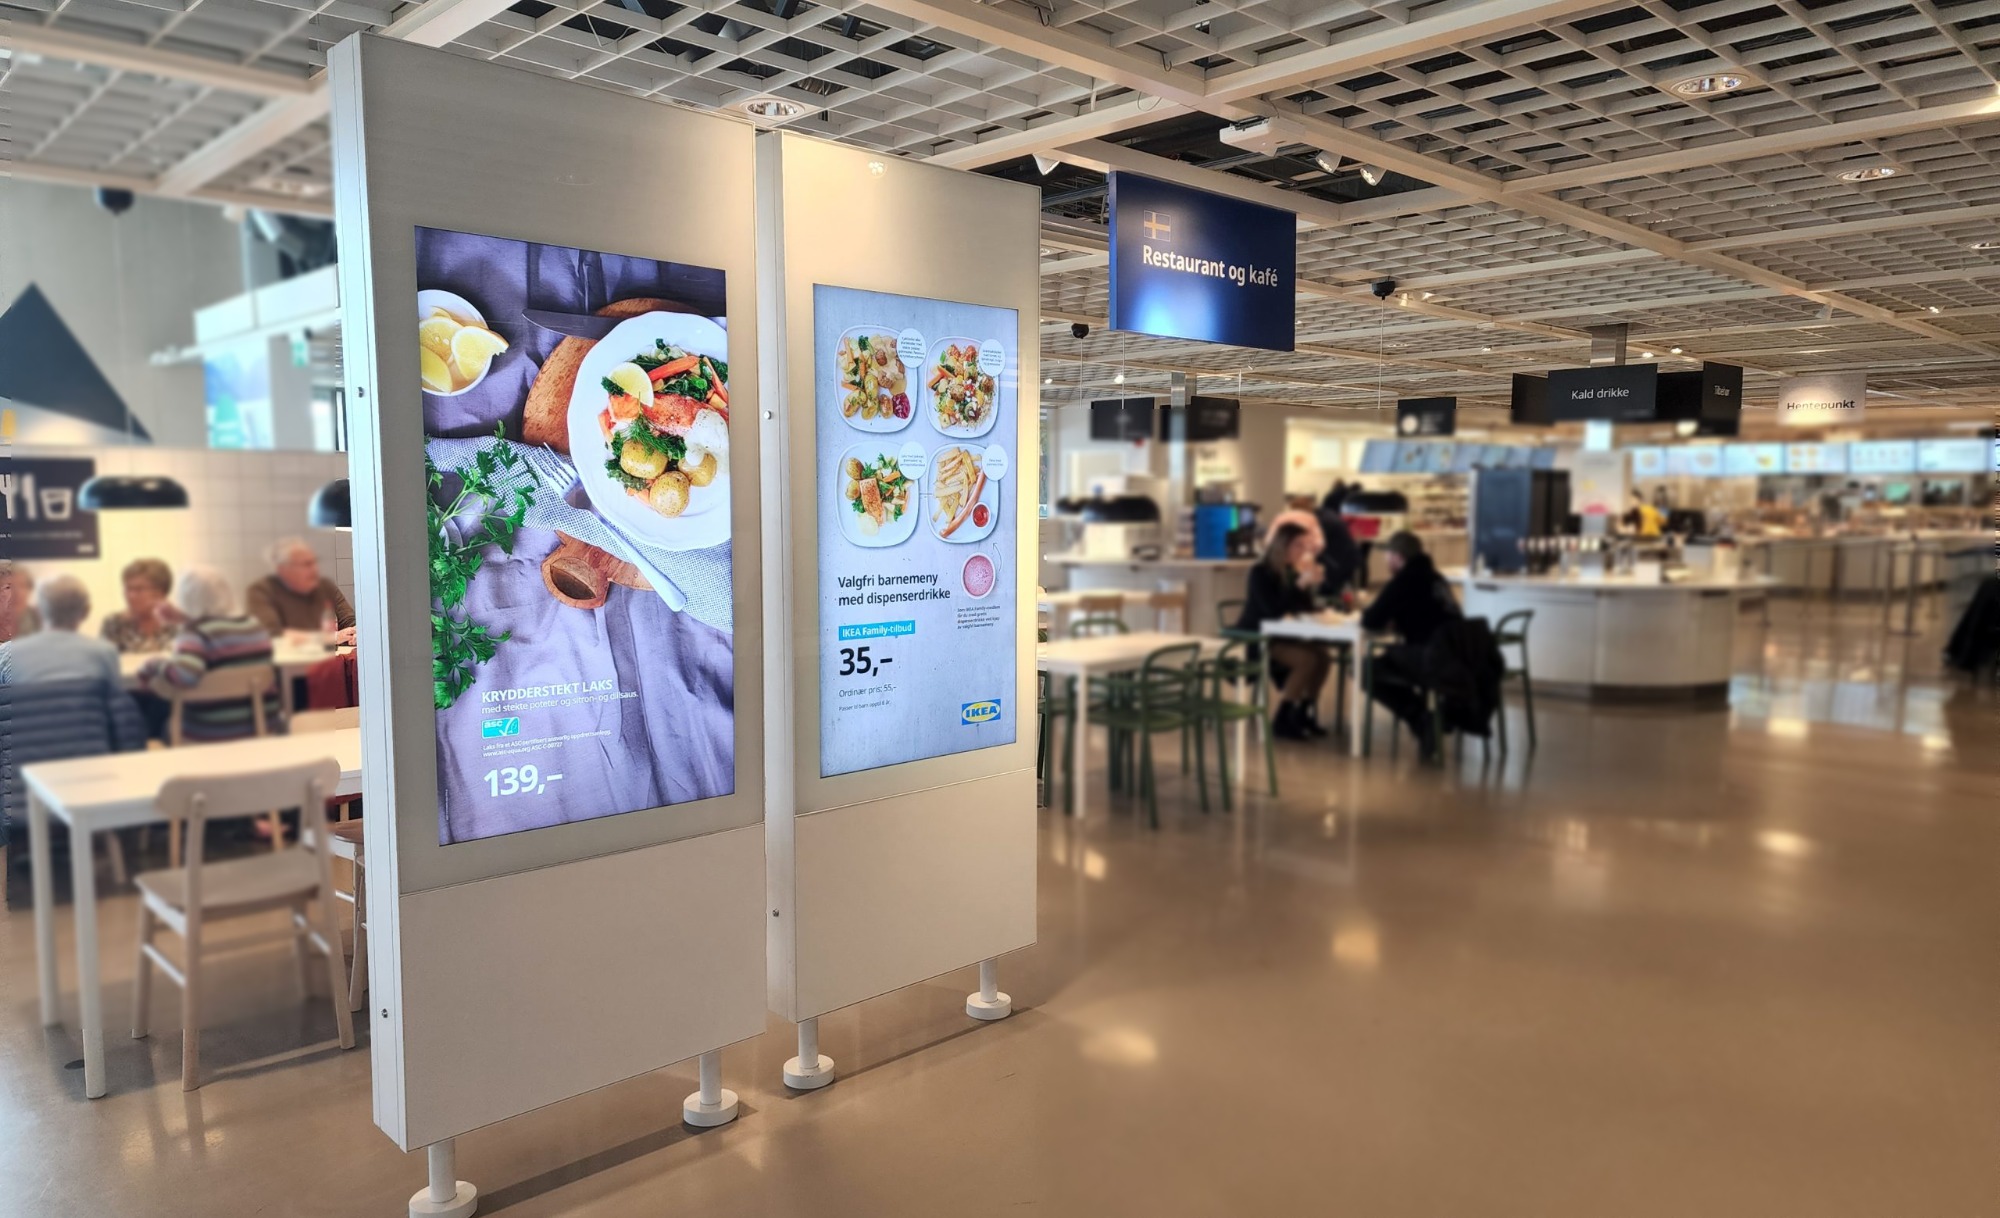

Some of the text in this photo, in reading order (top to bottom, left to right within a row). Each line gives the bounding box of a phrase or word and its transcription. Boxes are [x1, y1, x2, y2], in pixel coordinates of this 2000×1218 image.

[1143, 244, 1278, 287] Restaurant og kafé
[1571, 387, 1630, 400] Kald drikke
[838, 572, 939, 590] Valgfri barnemeny
[838, 588, 951, 606] med dispenserdrikke
[842, 623, 912, 638] IKEA Family-tilbud
[482, 679, 613, 703] KRYDDERSTEKT LAKS
[838, 688, 867, 697] Ordinær
[481, 690, 639, 714] med stekte poteter og sitron- og dillsaus.
[965, 705, 998, 718] IKEA
[484, 719, 503, 729] asc
